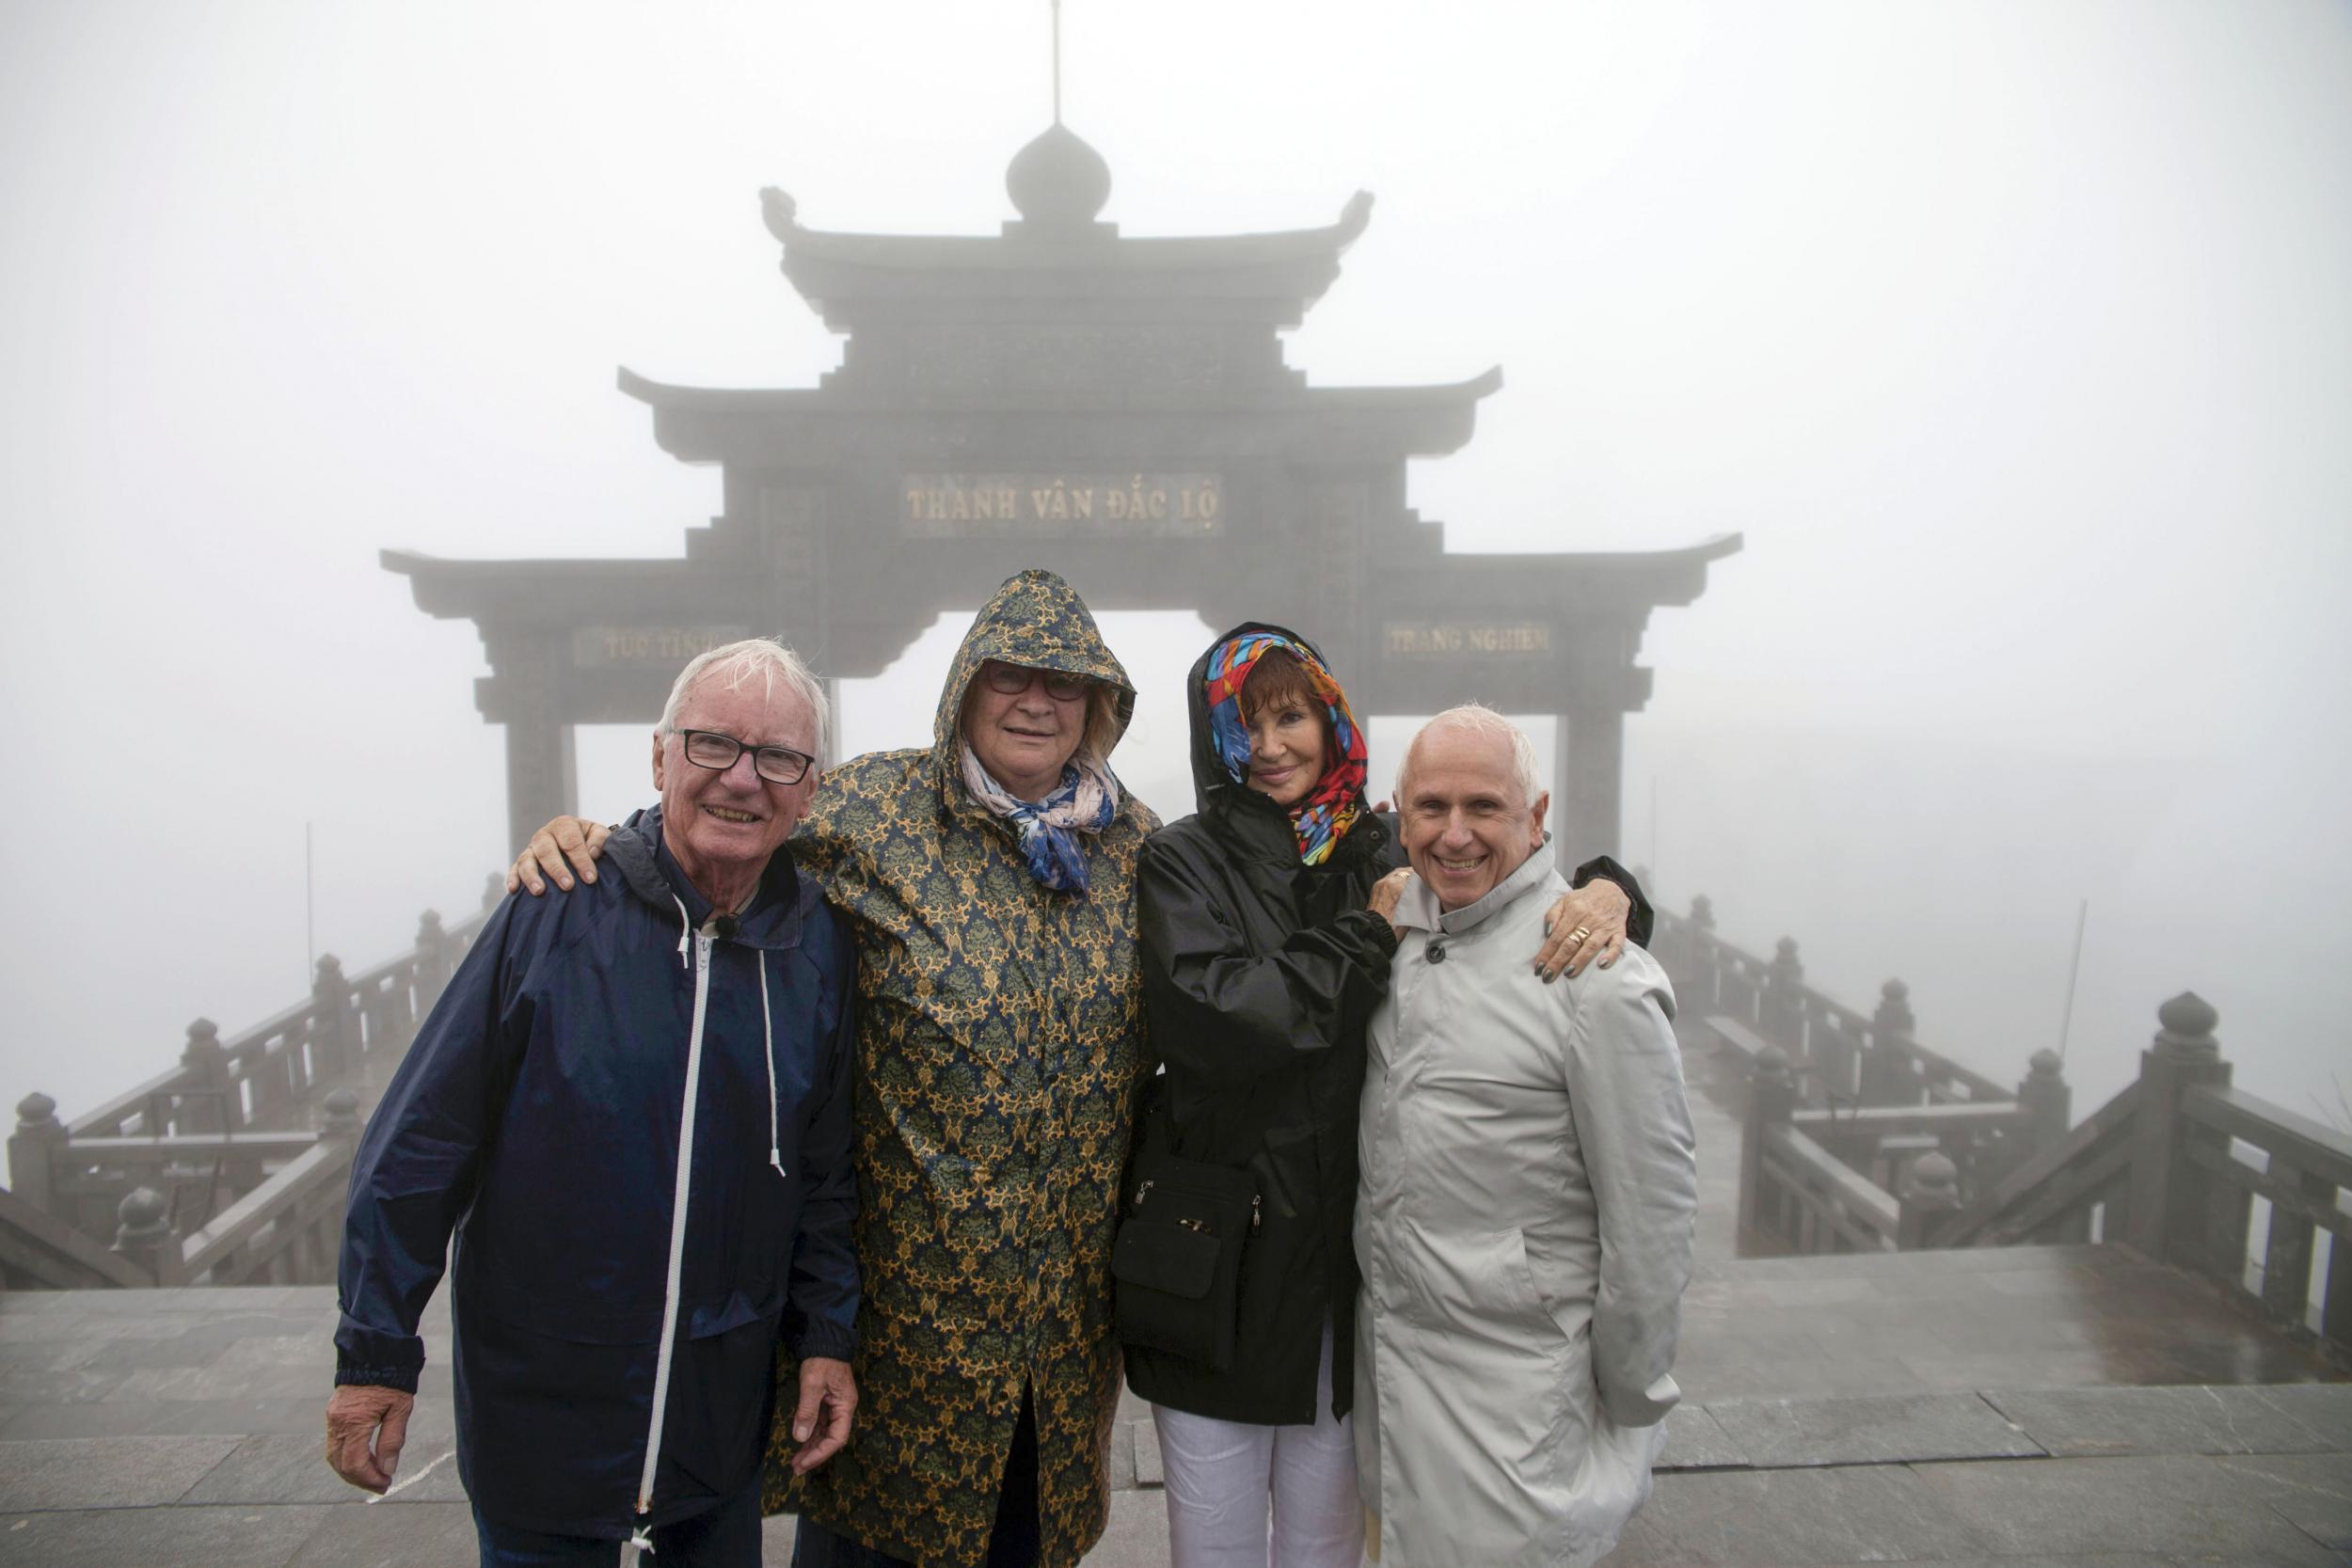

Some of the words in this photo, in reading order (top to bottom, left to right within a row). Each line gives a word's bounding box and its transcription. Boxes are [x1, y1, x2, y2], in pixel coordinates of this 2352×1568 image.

[907, 488, 1017, 519] THANH
[1031, 478, 1093, 519] VÂN
[1106, 472, 1167, 519] ĐẮC
[1181, 478, 1218, 530] LỘ
[1391, 629, 1463, 652] TRANG
